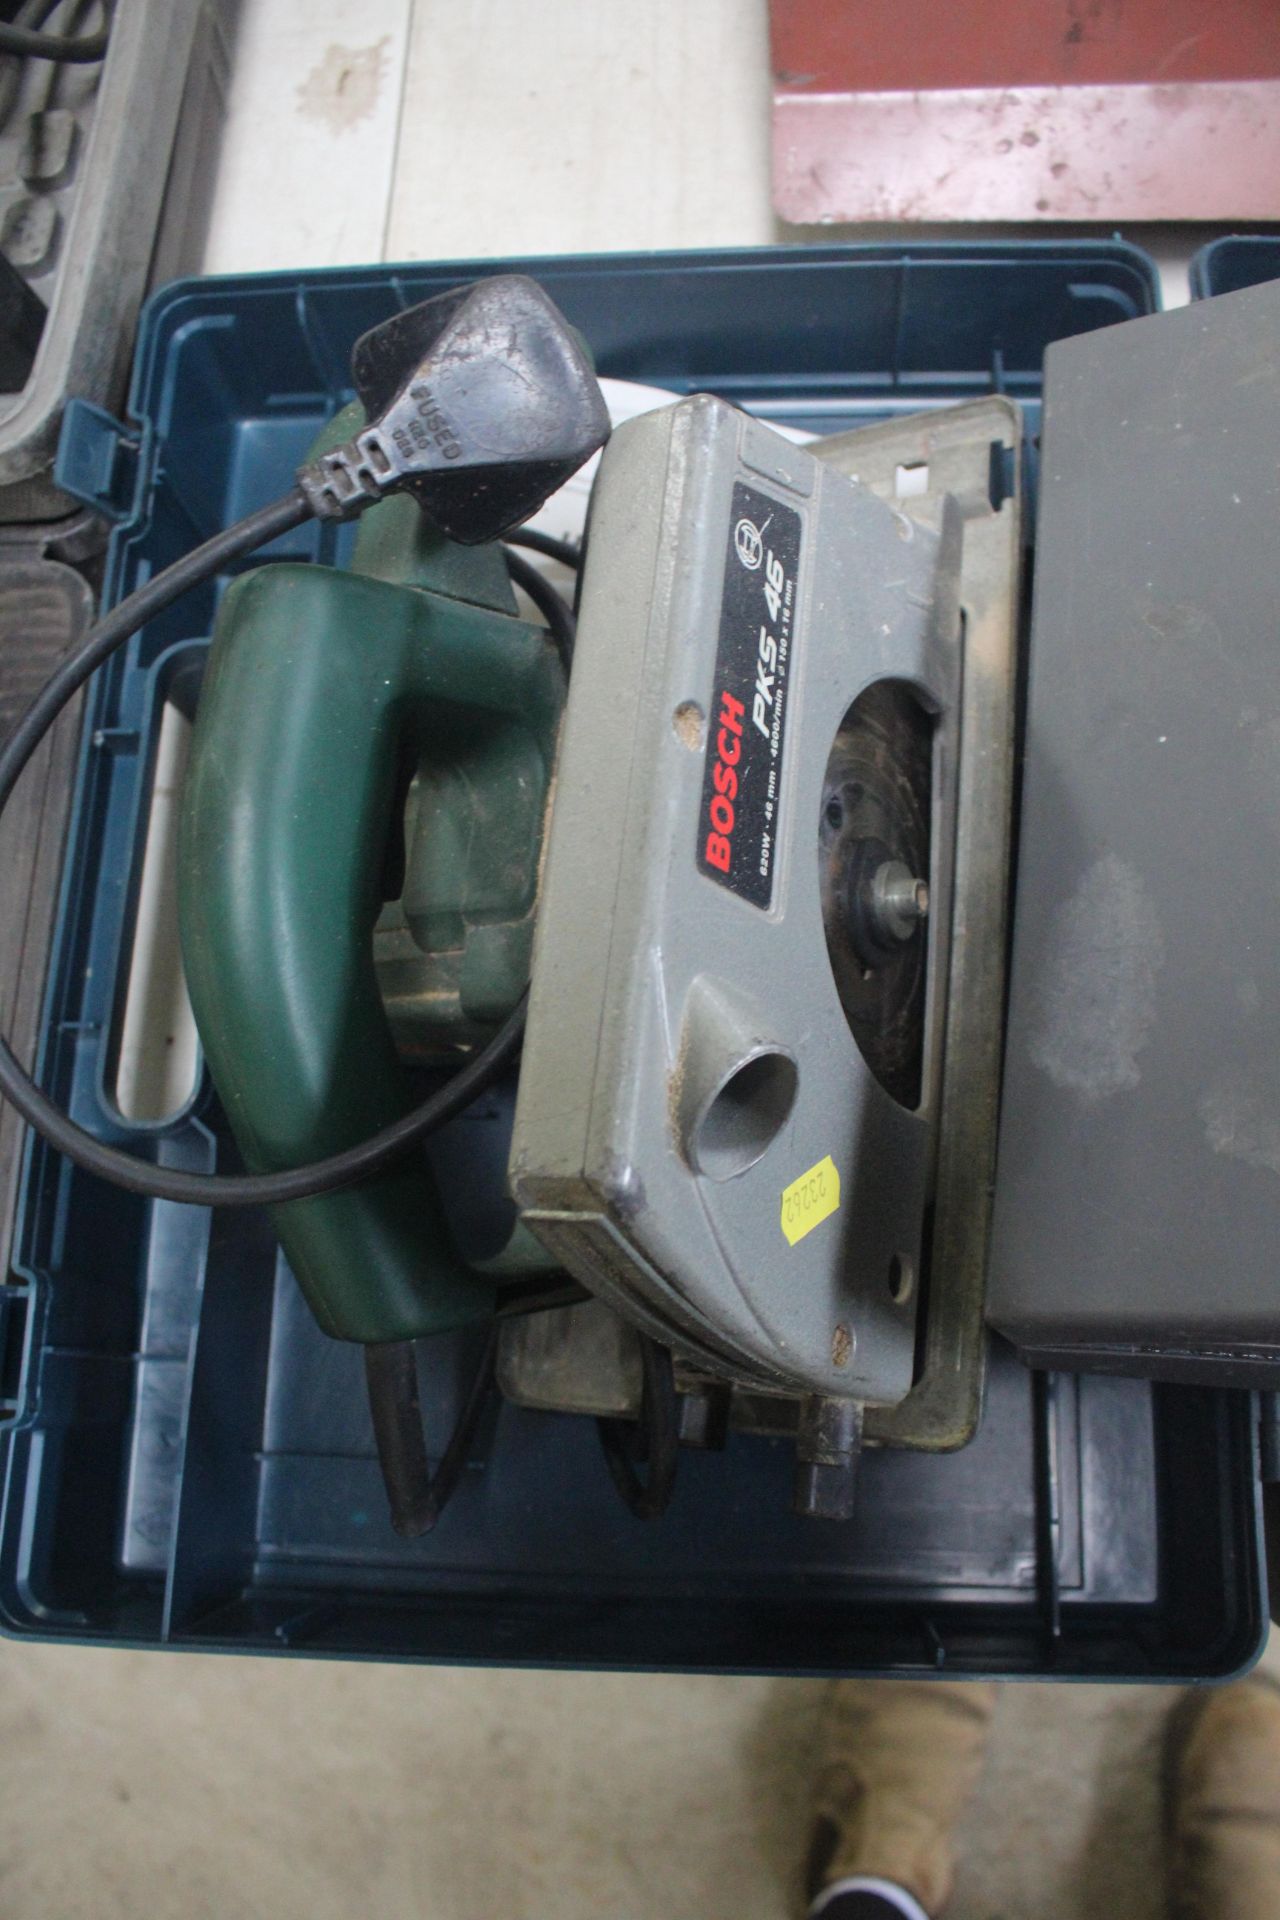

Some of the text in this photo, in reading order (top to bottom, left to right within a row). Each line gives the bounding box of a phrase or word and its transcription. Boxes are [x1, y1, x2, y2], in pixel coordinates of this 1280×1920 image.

[410, 385, 462, 460] FUSED
[784, 579, 793, 607] mm
[752, 549, 785, 738] PKS 46
[779, 637, 788, 662] 150
[770, 688, 783, 758] 4600/min
[705, 690, 746, 873] BOSCH
[768, 770, 777, 799] mm
[764, 801, 774, 821] 46
[759, 832, 771, 877] 620W
[785, 1171, 827, 1223] 23262
